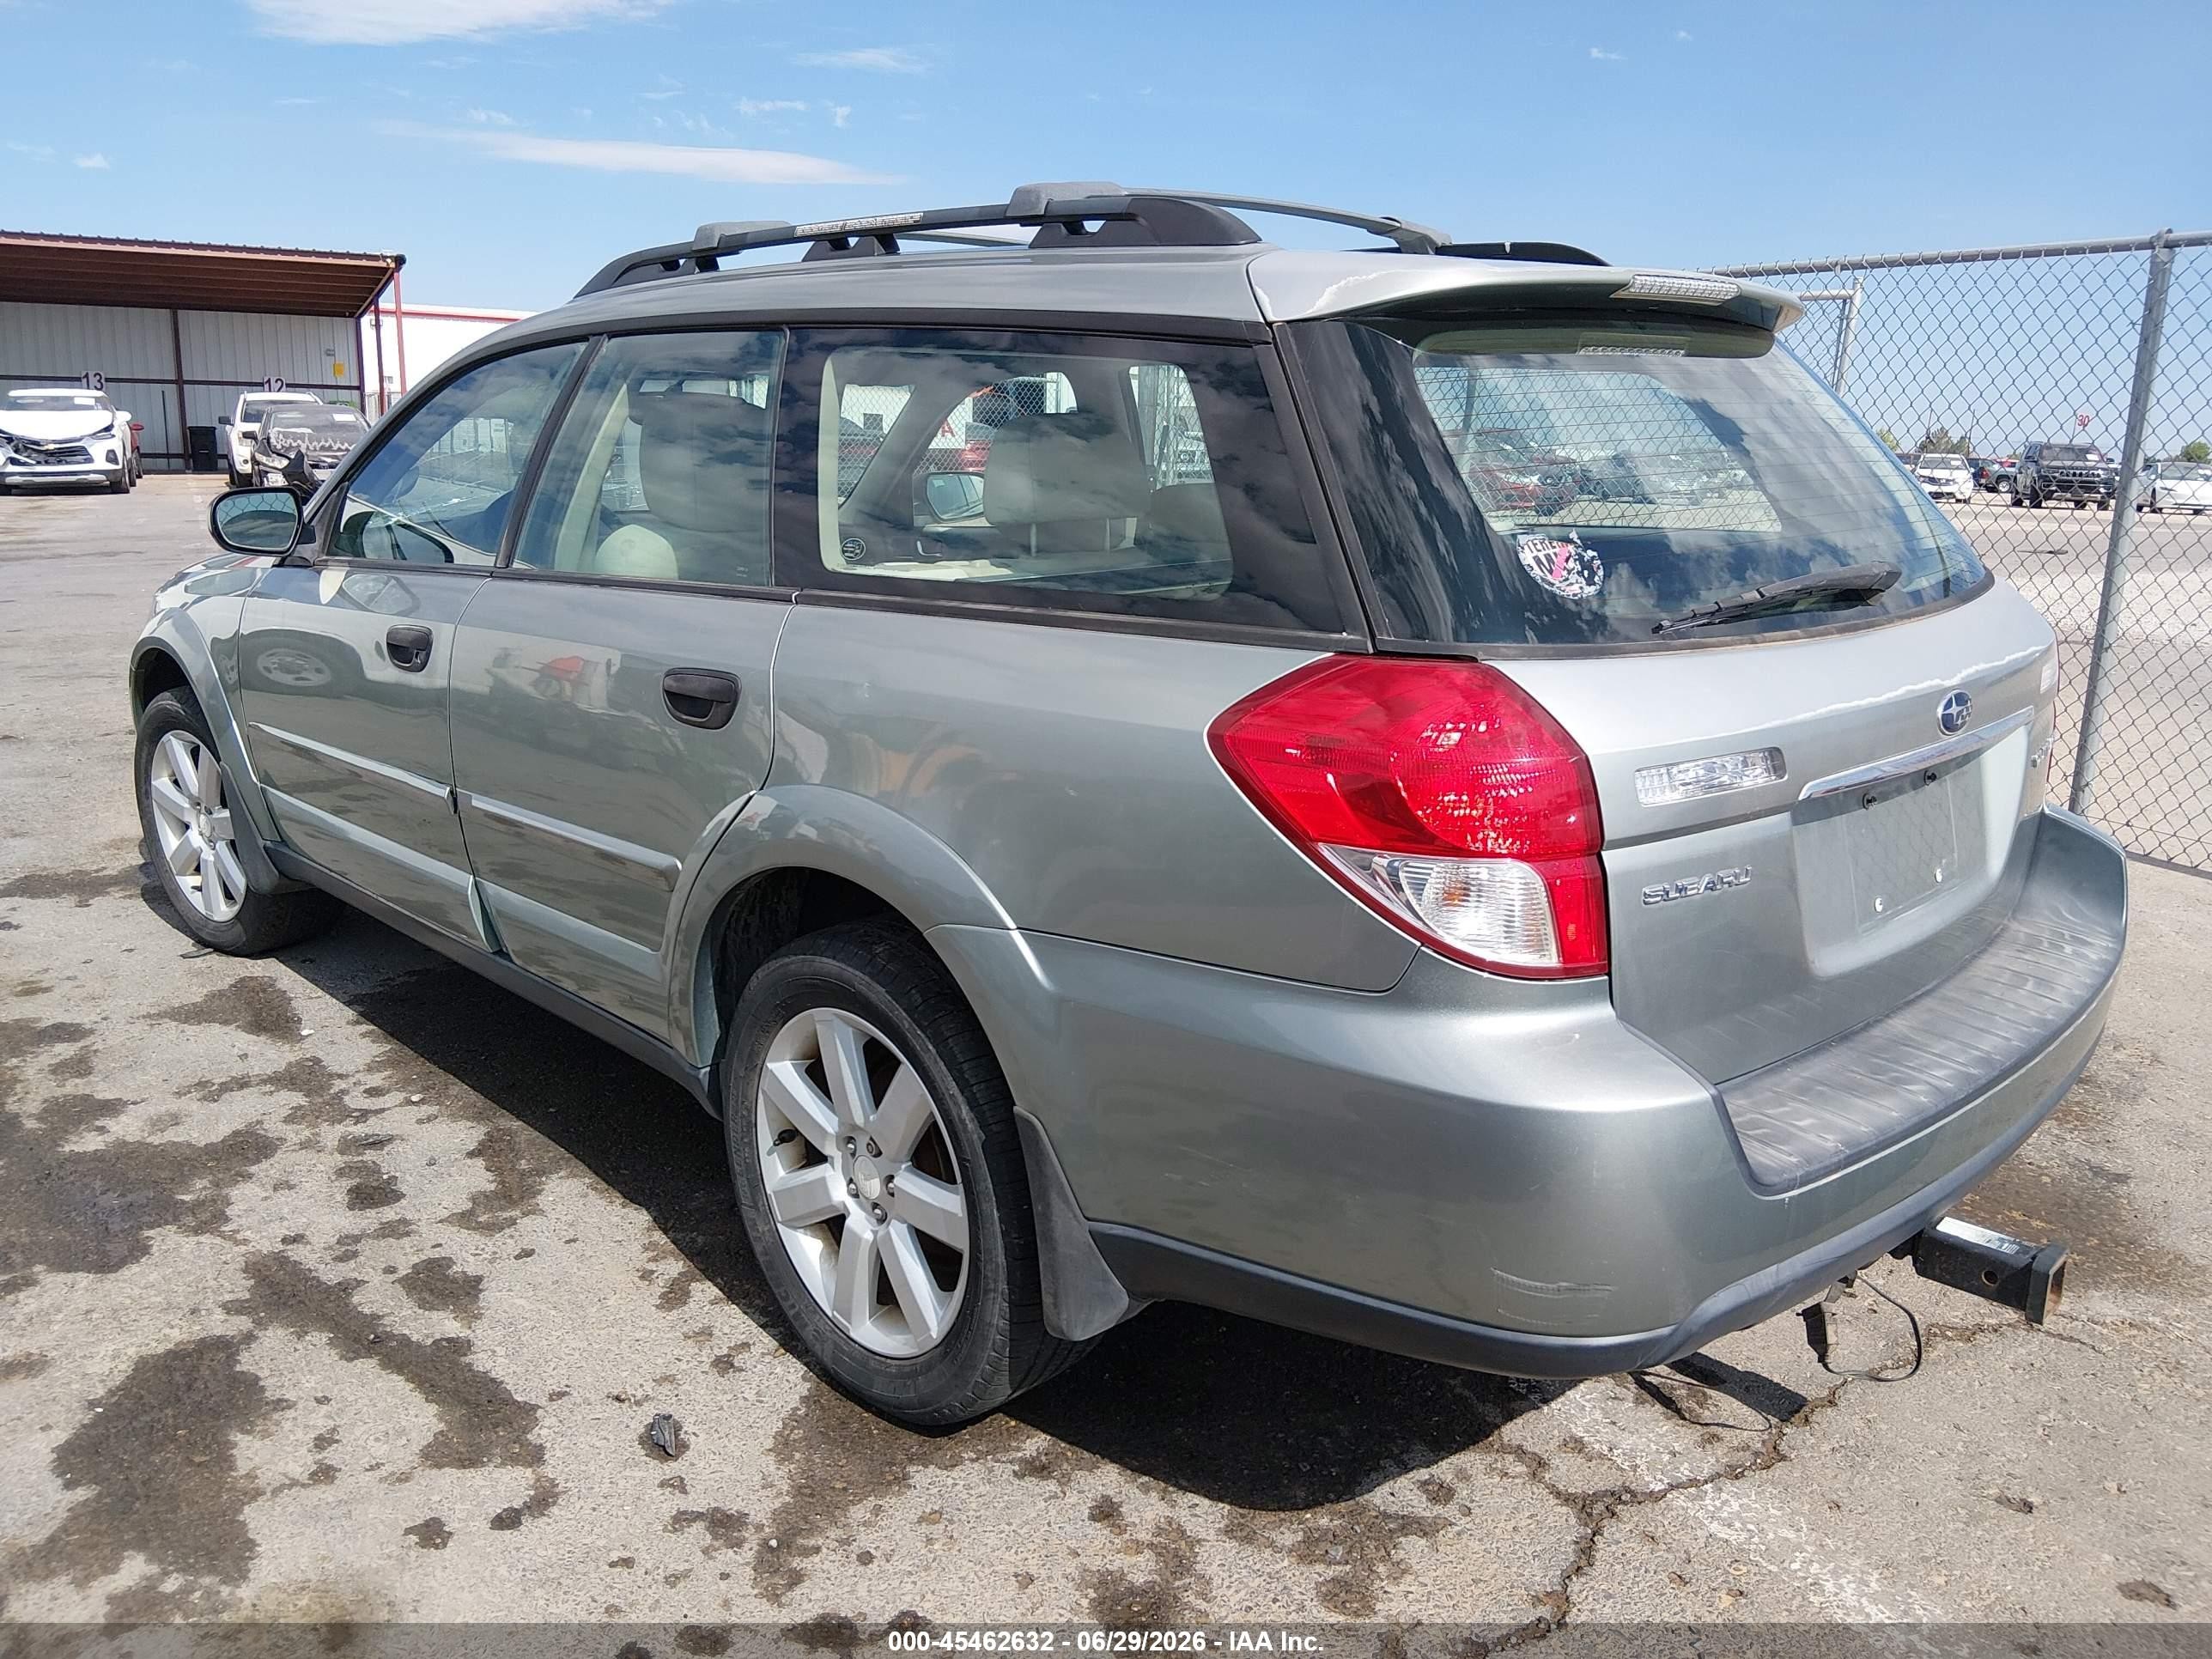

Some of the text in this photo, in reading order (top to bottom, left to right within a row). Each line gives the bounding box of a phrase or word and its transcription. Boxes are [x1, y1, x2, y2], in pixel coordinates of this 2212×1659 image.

[83, 372, 104, 391] 13
[264, 378, 285, 392] 12
[2077, 414, 2090, 427] 30
[1642, 865, 1753, 906] SUBARU
